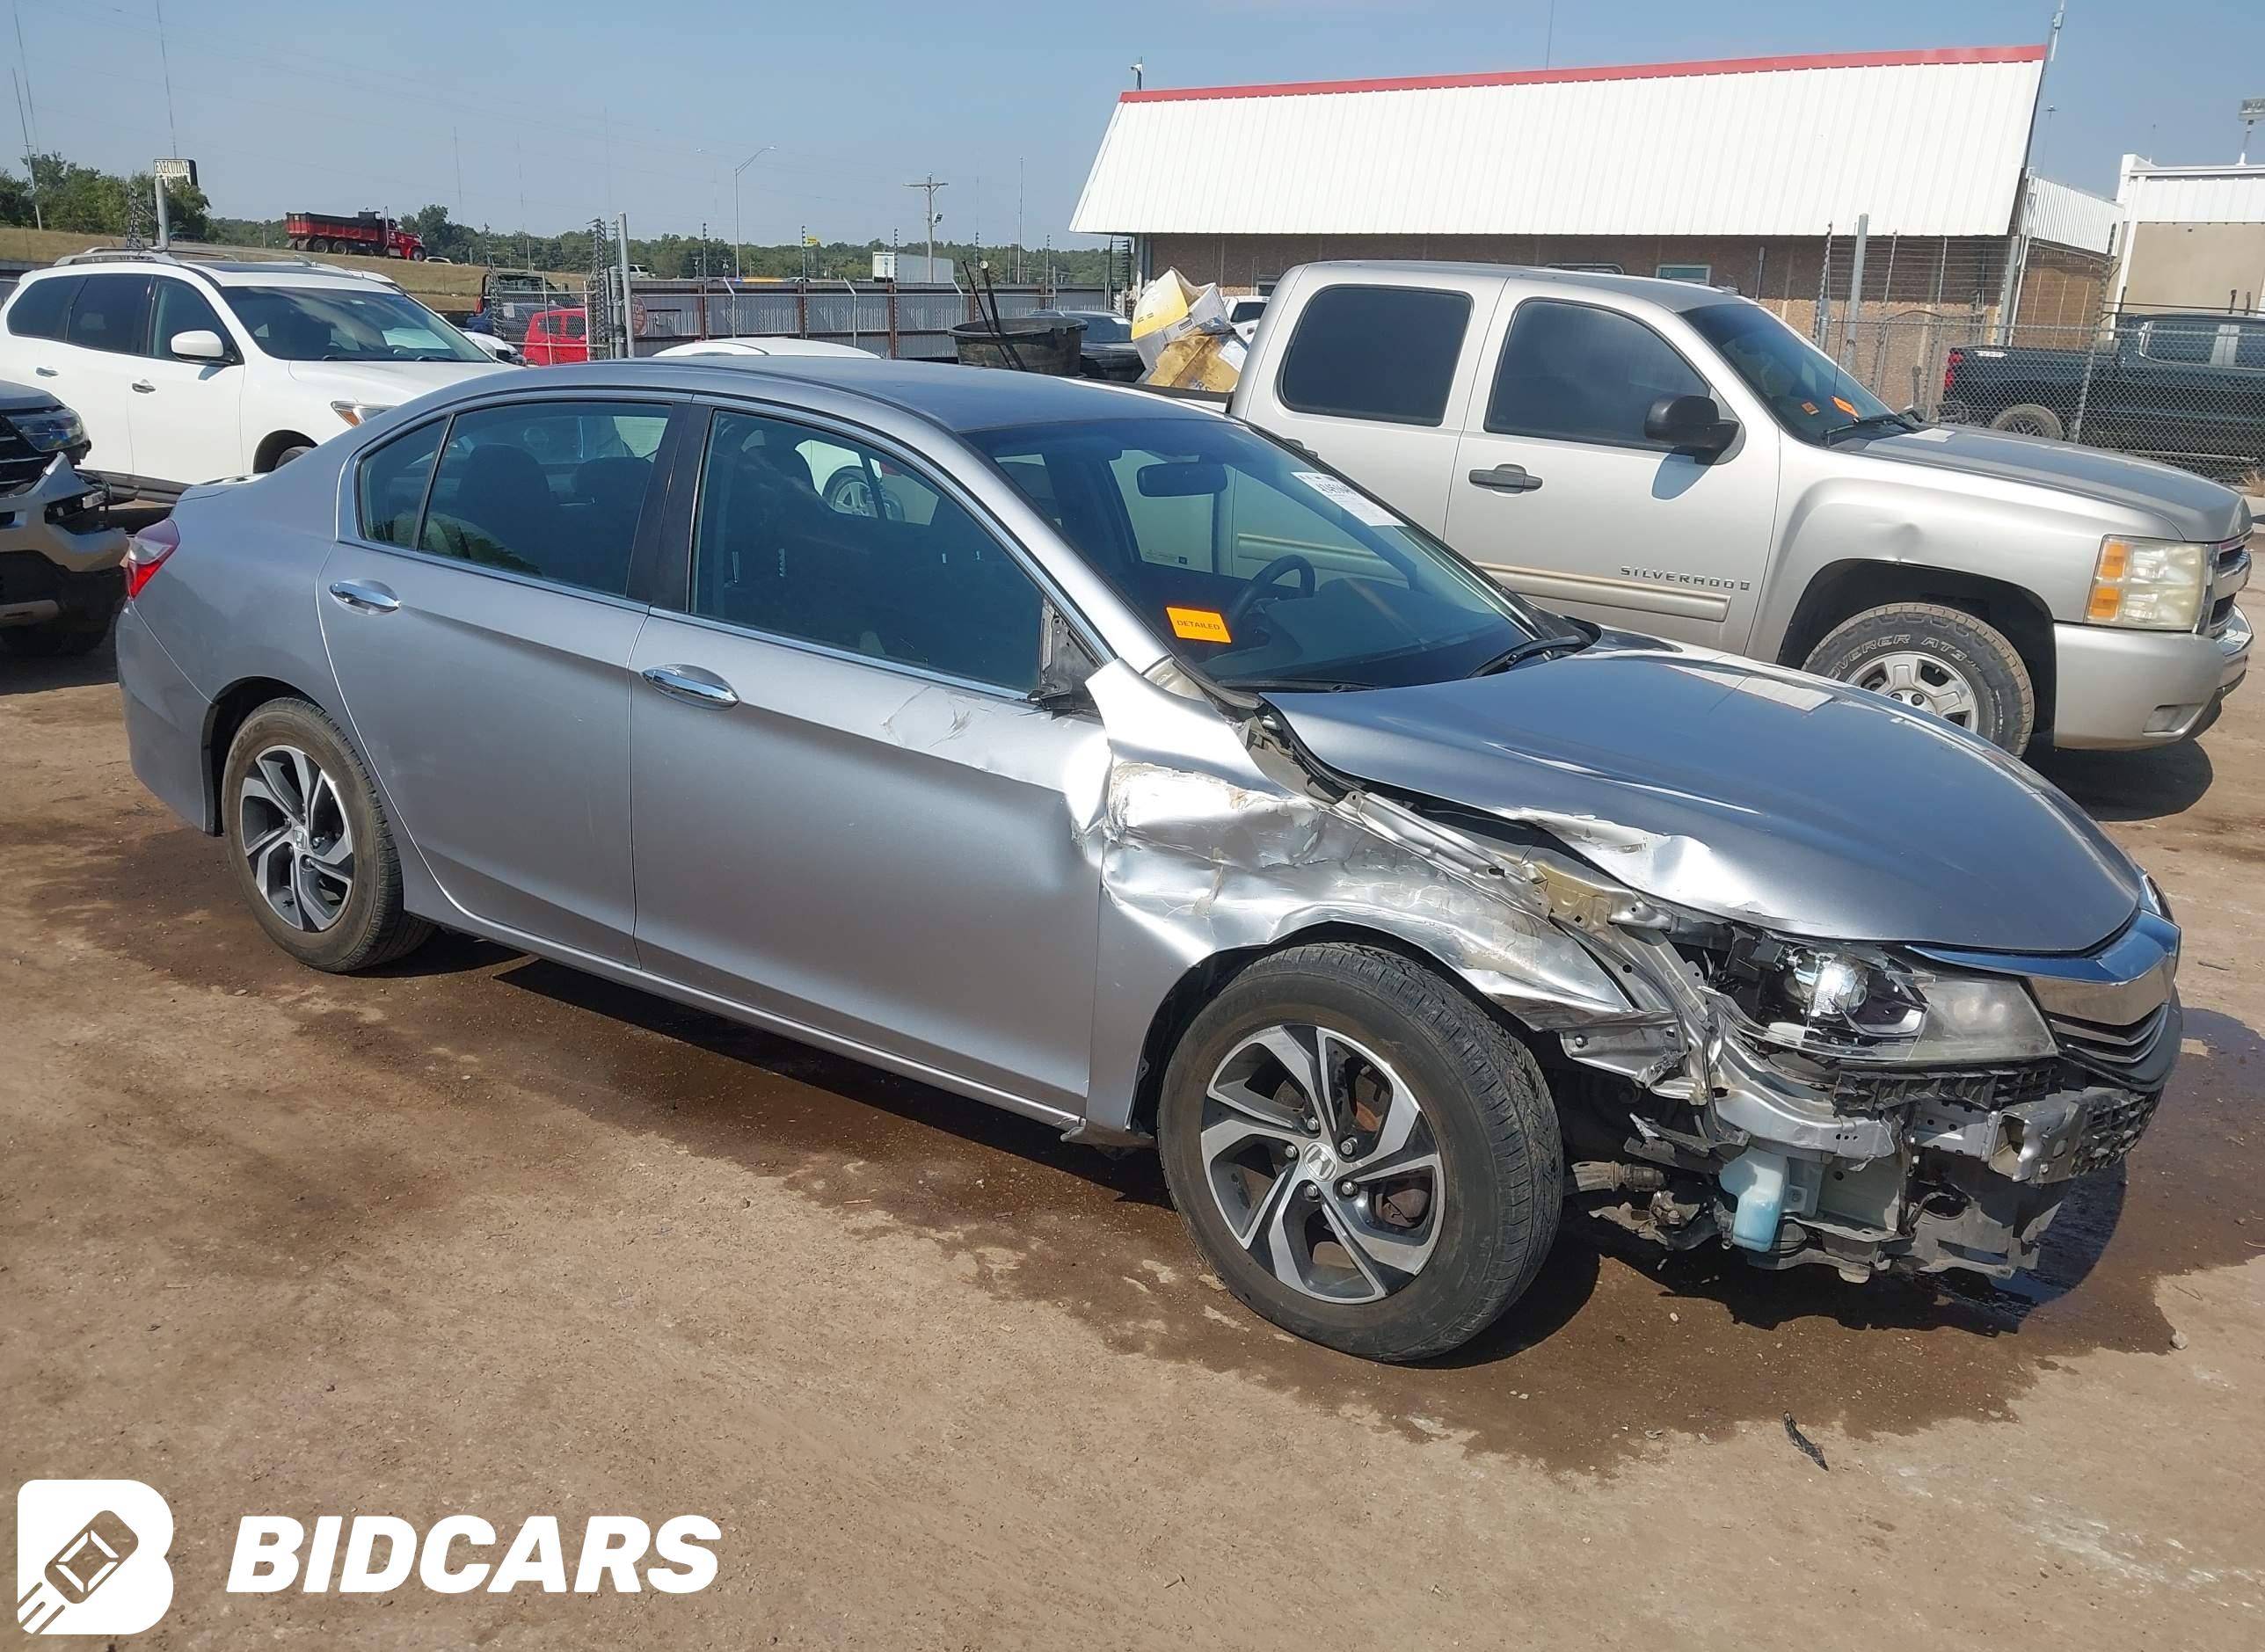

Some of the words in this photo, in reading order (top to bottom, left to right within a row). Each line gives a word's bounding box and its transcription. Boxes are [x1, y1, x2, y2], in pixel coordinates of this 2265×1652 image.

[155, 160, 190, 174] EXECUTIVE
[1620, 564, 1736, 590] SILVERADO
[1176, 619, 1220, 630] DETAILED
[1827, 634, 1911, 680] OVERER
[1920, 637, 1968, 661] AT3
